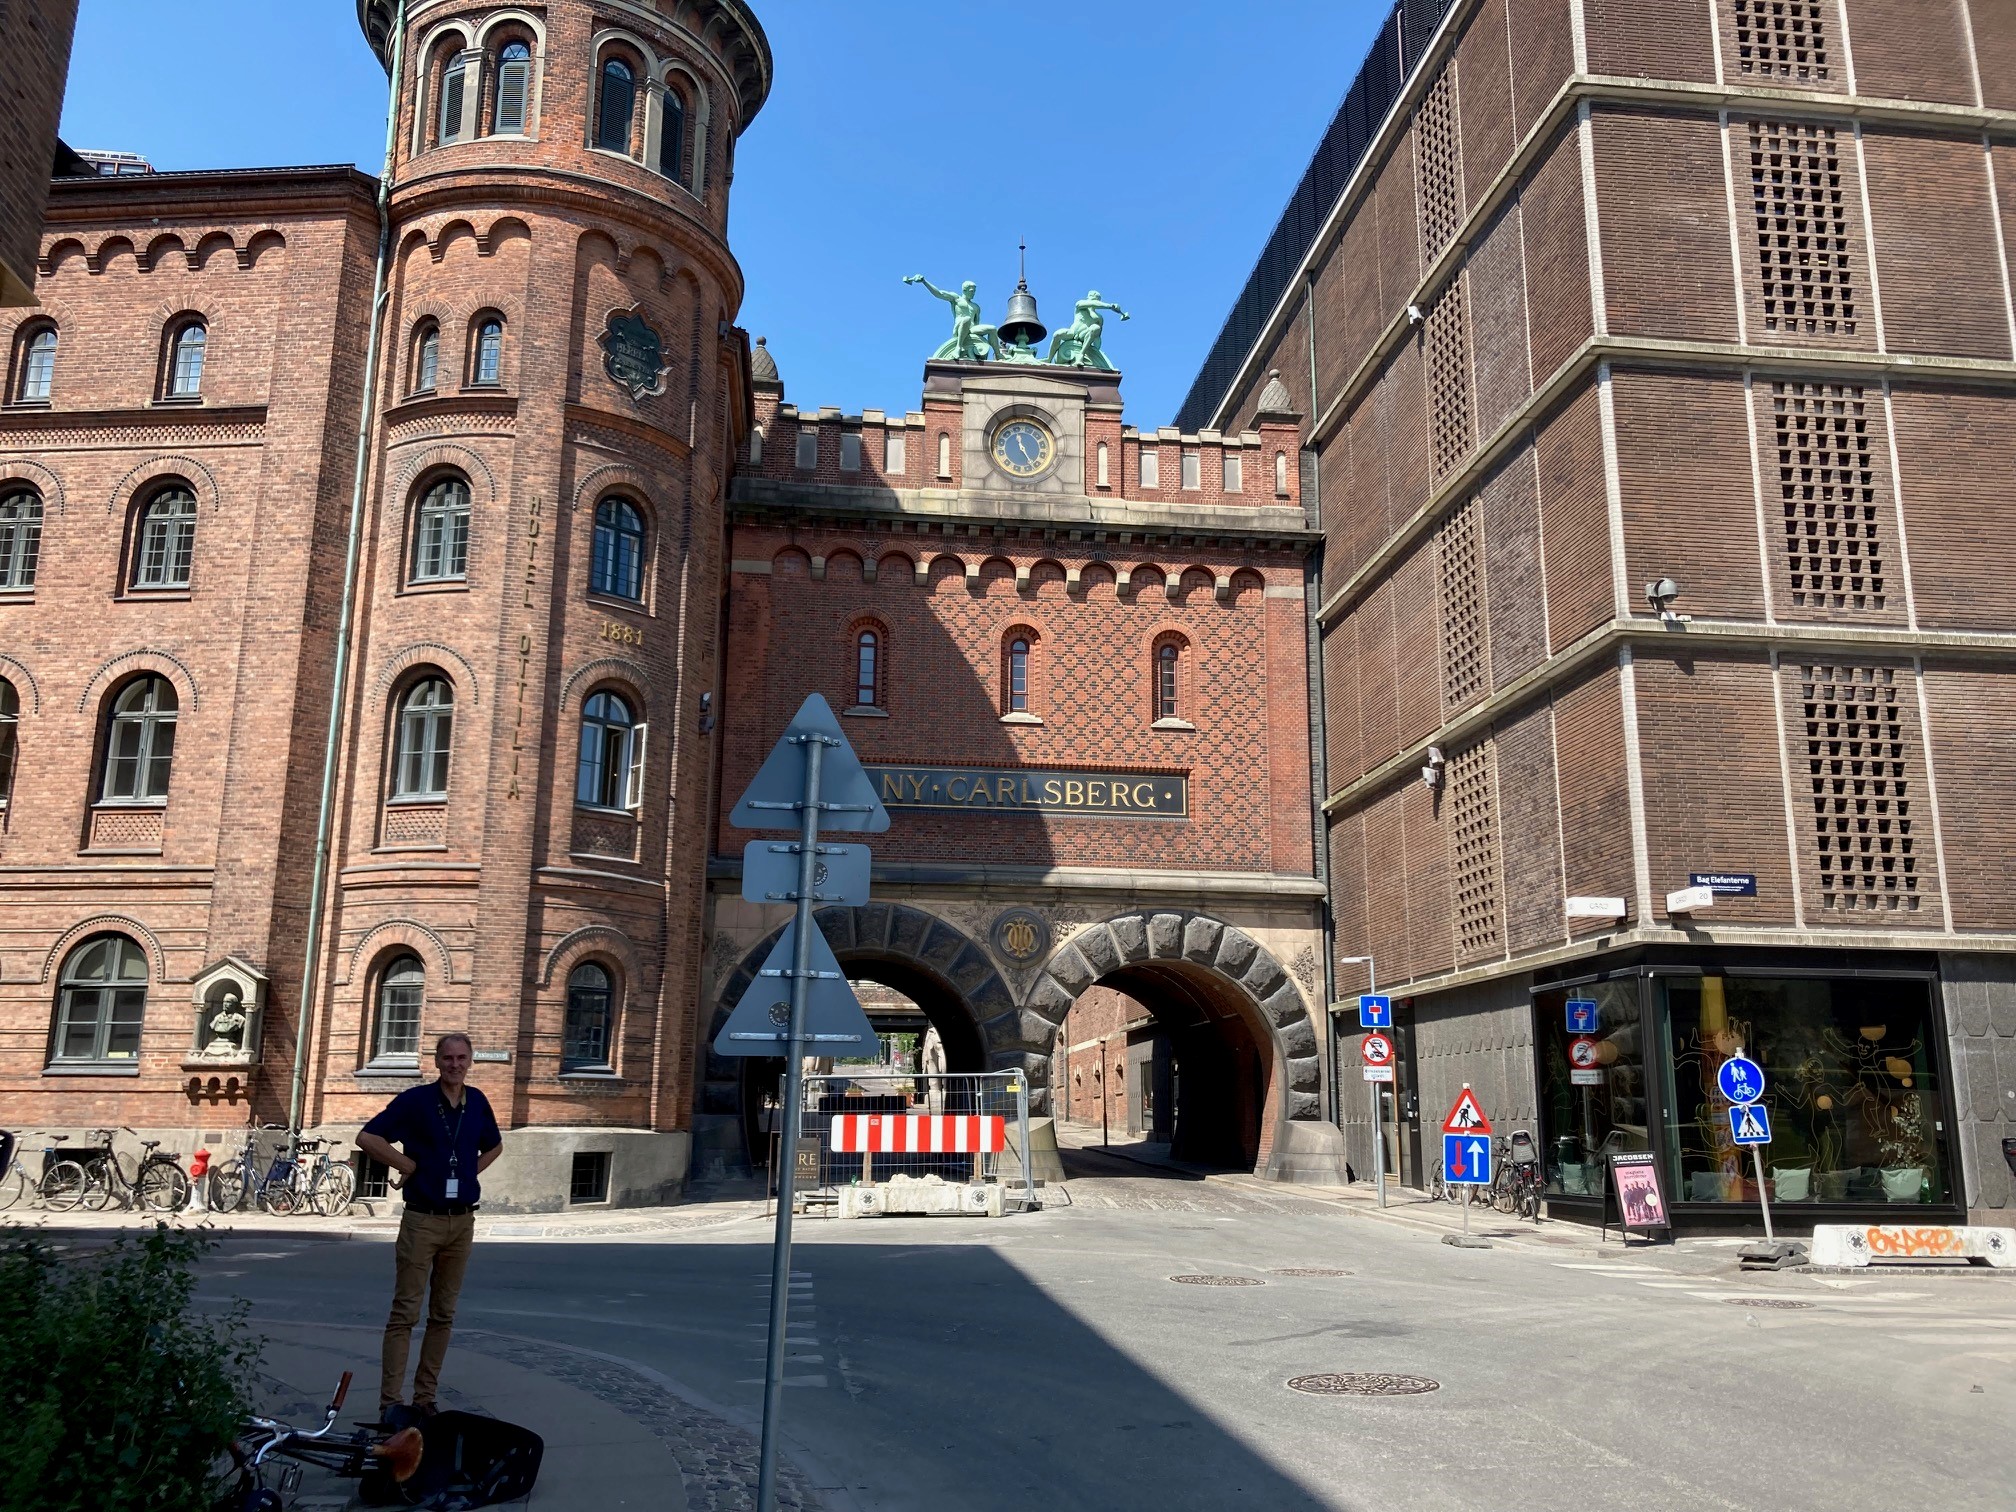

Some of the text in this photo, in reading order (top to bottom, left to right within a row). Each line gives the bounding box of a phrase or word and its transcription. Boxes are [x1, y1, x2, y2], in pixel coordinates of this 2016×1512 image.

[600, 621, 643, 646] 1881
[508, 496, 541, 800] HOTEL OTTILIA
[882, 774, 1156, 808] NY CARLSBERG
[1696, 876, 1750, 885] Bag Elefanterne
[798, 1153, 817, 1166] RE
